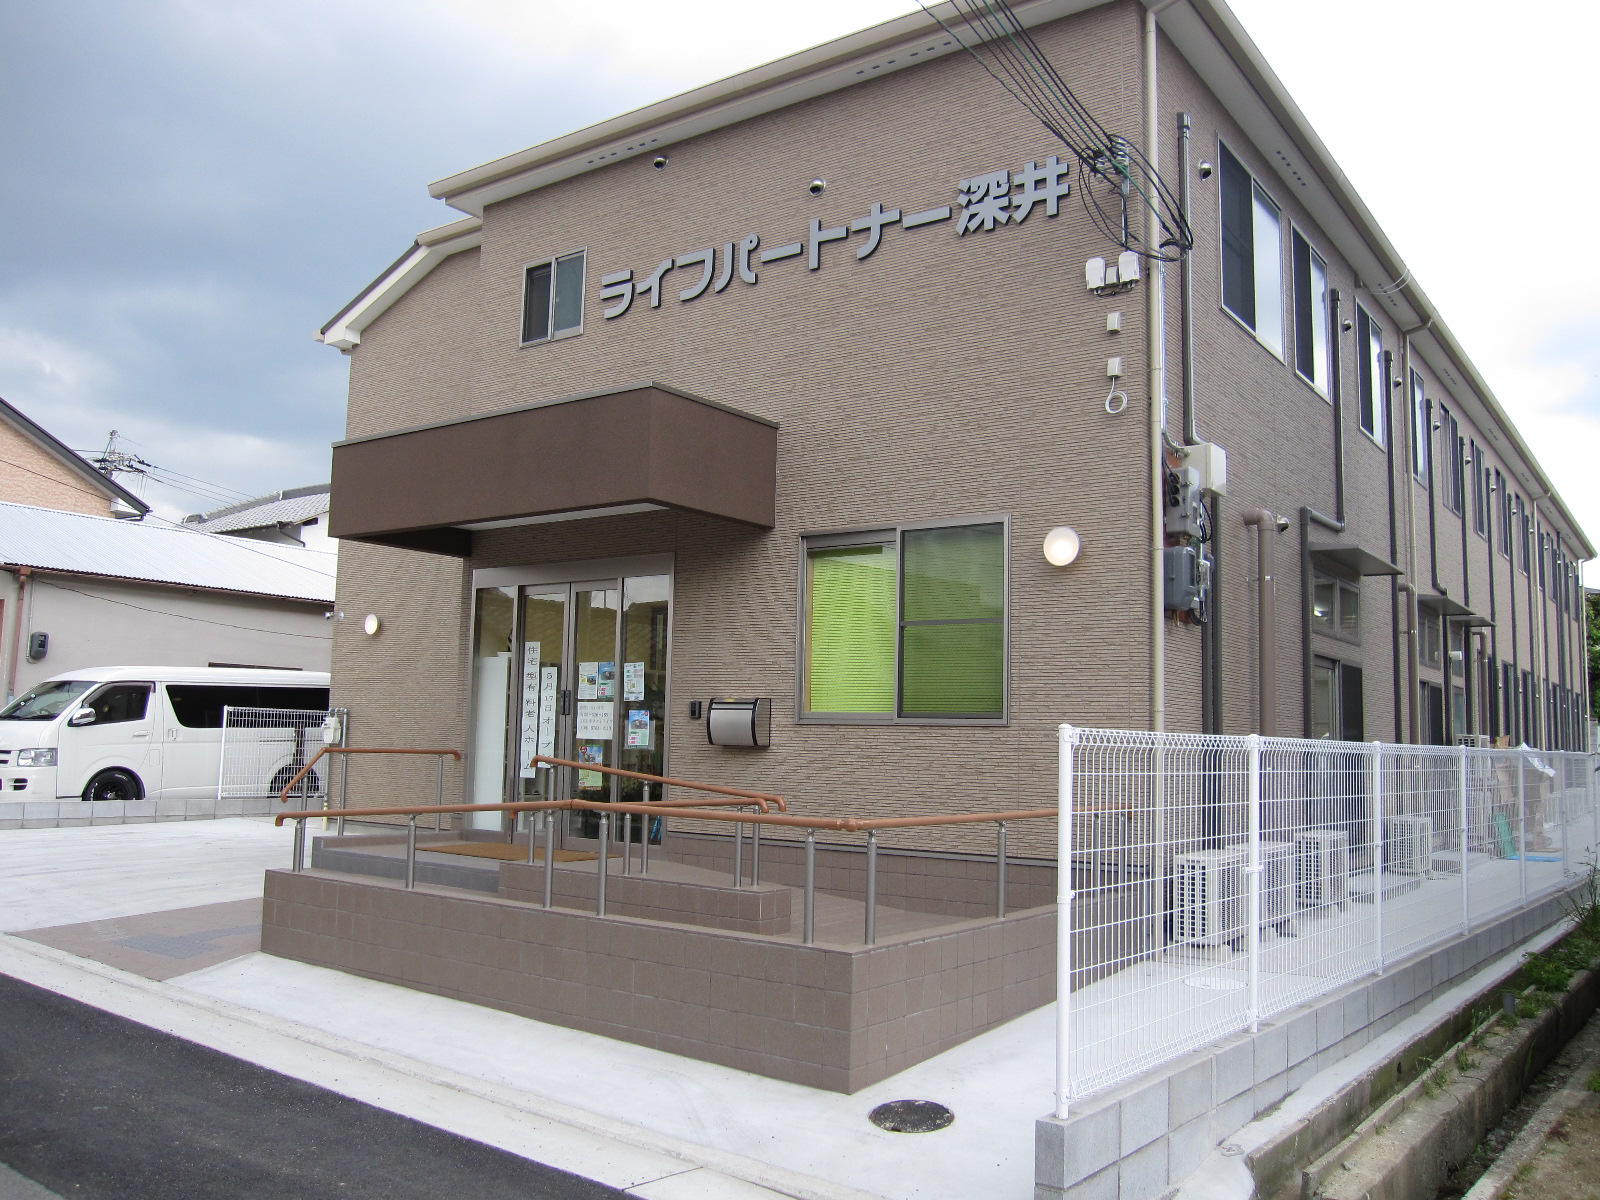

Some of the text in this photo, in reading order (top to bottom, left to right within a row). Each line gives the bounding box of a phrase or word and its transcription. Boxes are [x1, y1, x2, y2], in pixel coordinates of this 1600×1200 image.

[599, 155, 1070, 320] ライフパートナー深井
[542, 672, 554, 757] 5月17日オープ
